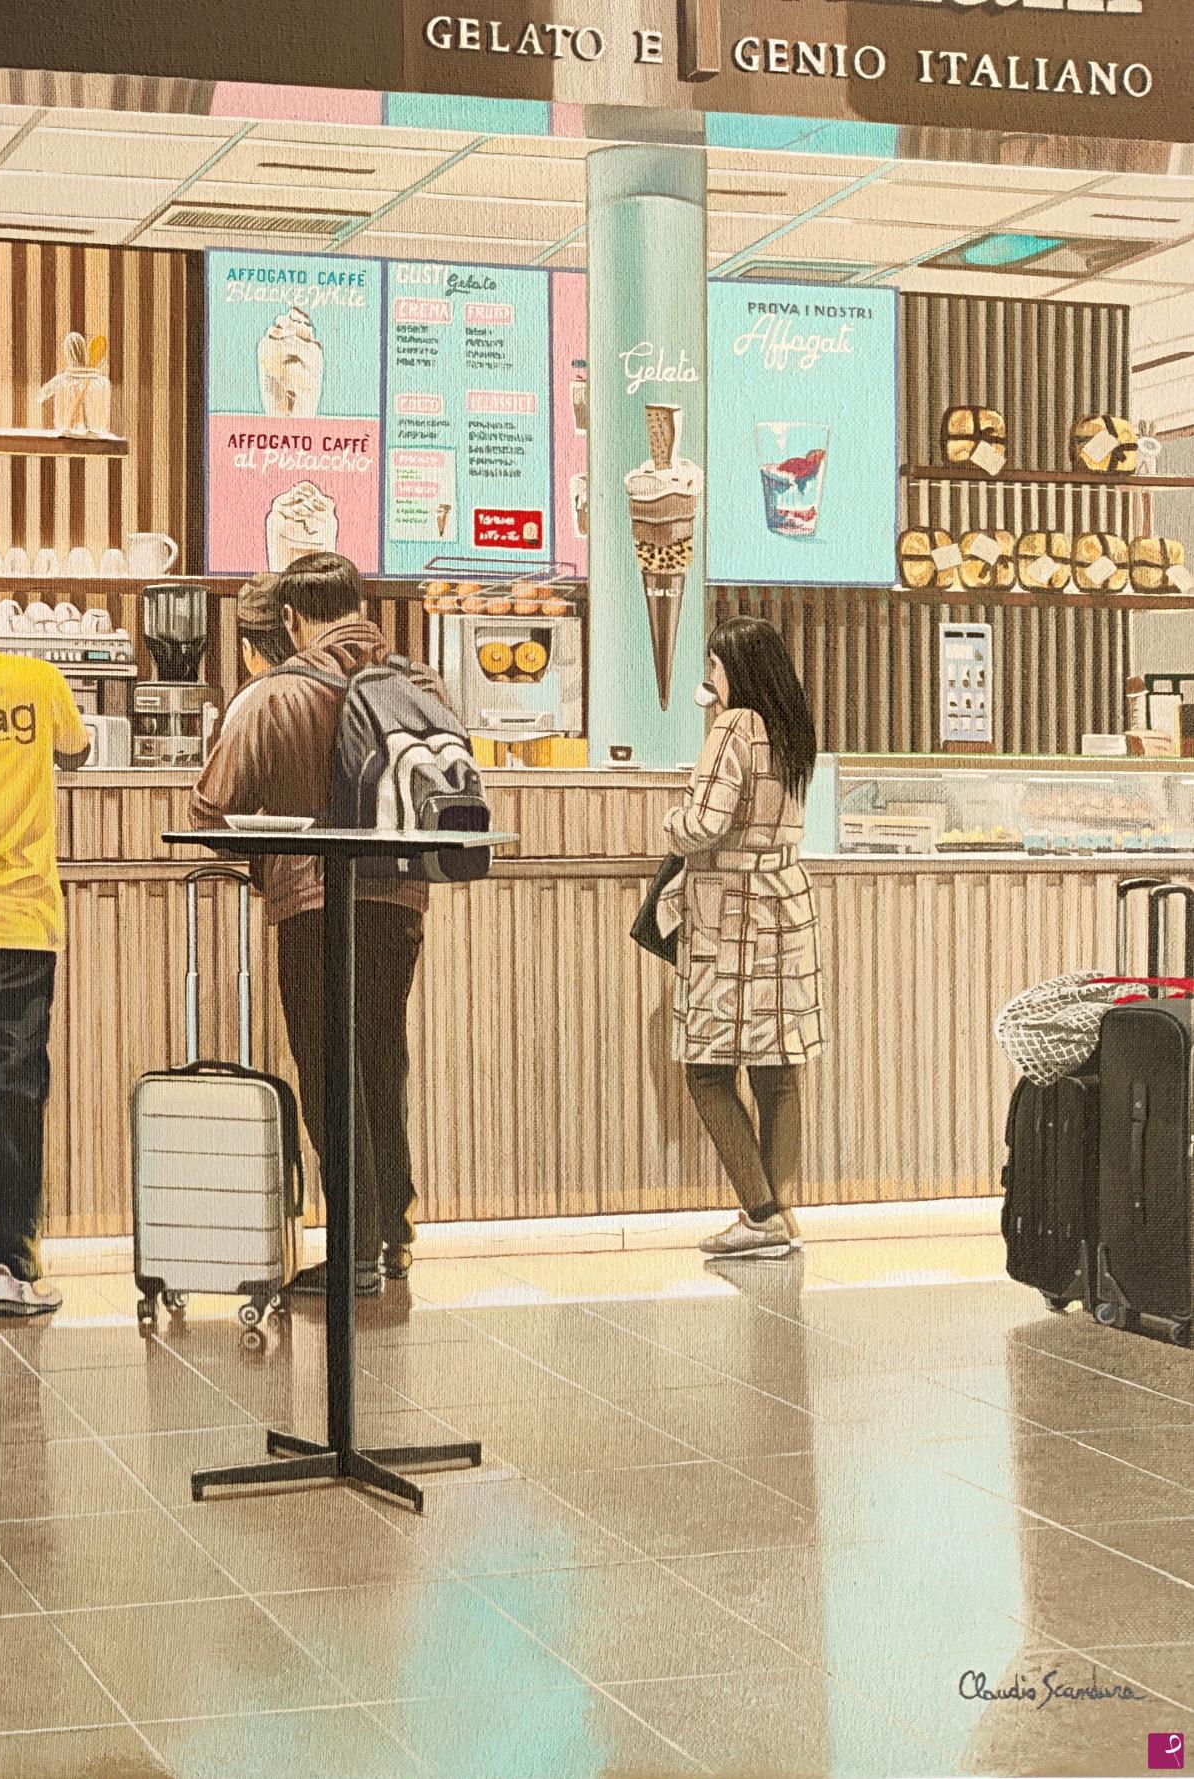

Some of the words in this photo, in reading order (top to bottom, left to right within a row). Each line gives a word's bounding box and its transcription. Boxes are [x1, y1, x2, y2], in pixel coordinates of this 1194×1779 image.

[425, 16, 605, 61] GELATO
[635, 30, 663, 63] E
[734, 36, 887, 80] GENIO
[918, 49, 1153, 98] ITALIANO
[226, 267, 308, 284] AFFOGATO
[748, 301, 800, 316] PROVA
[814, 304, 873, 319] NOSTRI
[618, 341, 699, 395] Gelato
[227, 434, 312, 451] AFFOGATO
[323, 433, 370, 453] CAFFÈ
[234, 450, 257, 469] al
[959, 1670, 1036, 1701] Claudio
